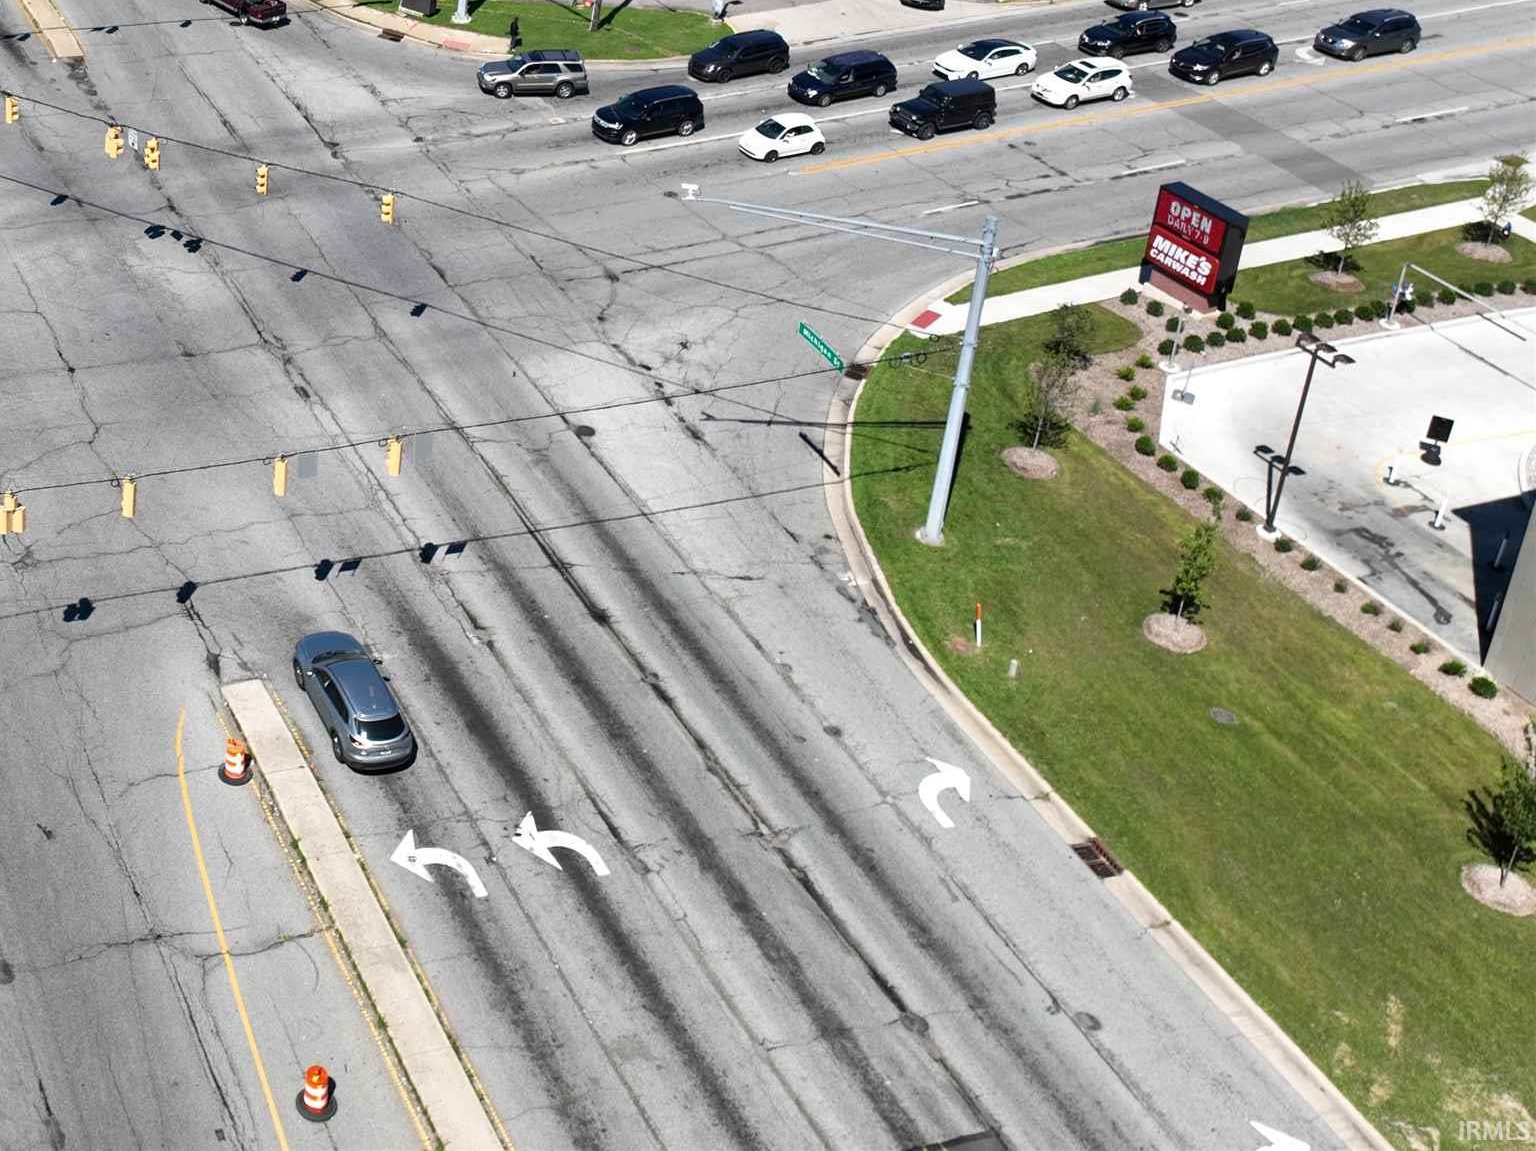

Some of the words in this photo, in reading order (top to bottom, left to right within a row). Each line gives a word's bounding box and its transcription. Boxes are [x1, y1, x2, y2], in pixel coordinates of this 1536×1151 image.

[1167, 214, 1192, 236] DAILY
[1170, 201, 1213, 235] OPEN
[1149, 249, 1207, 286] CARWASH
